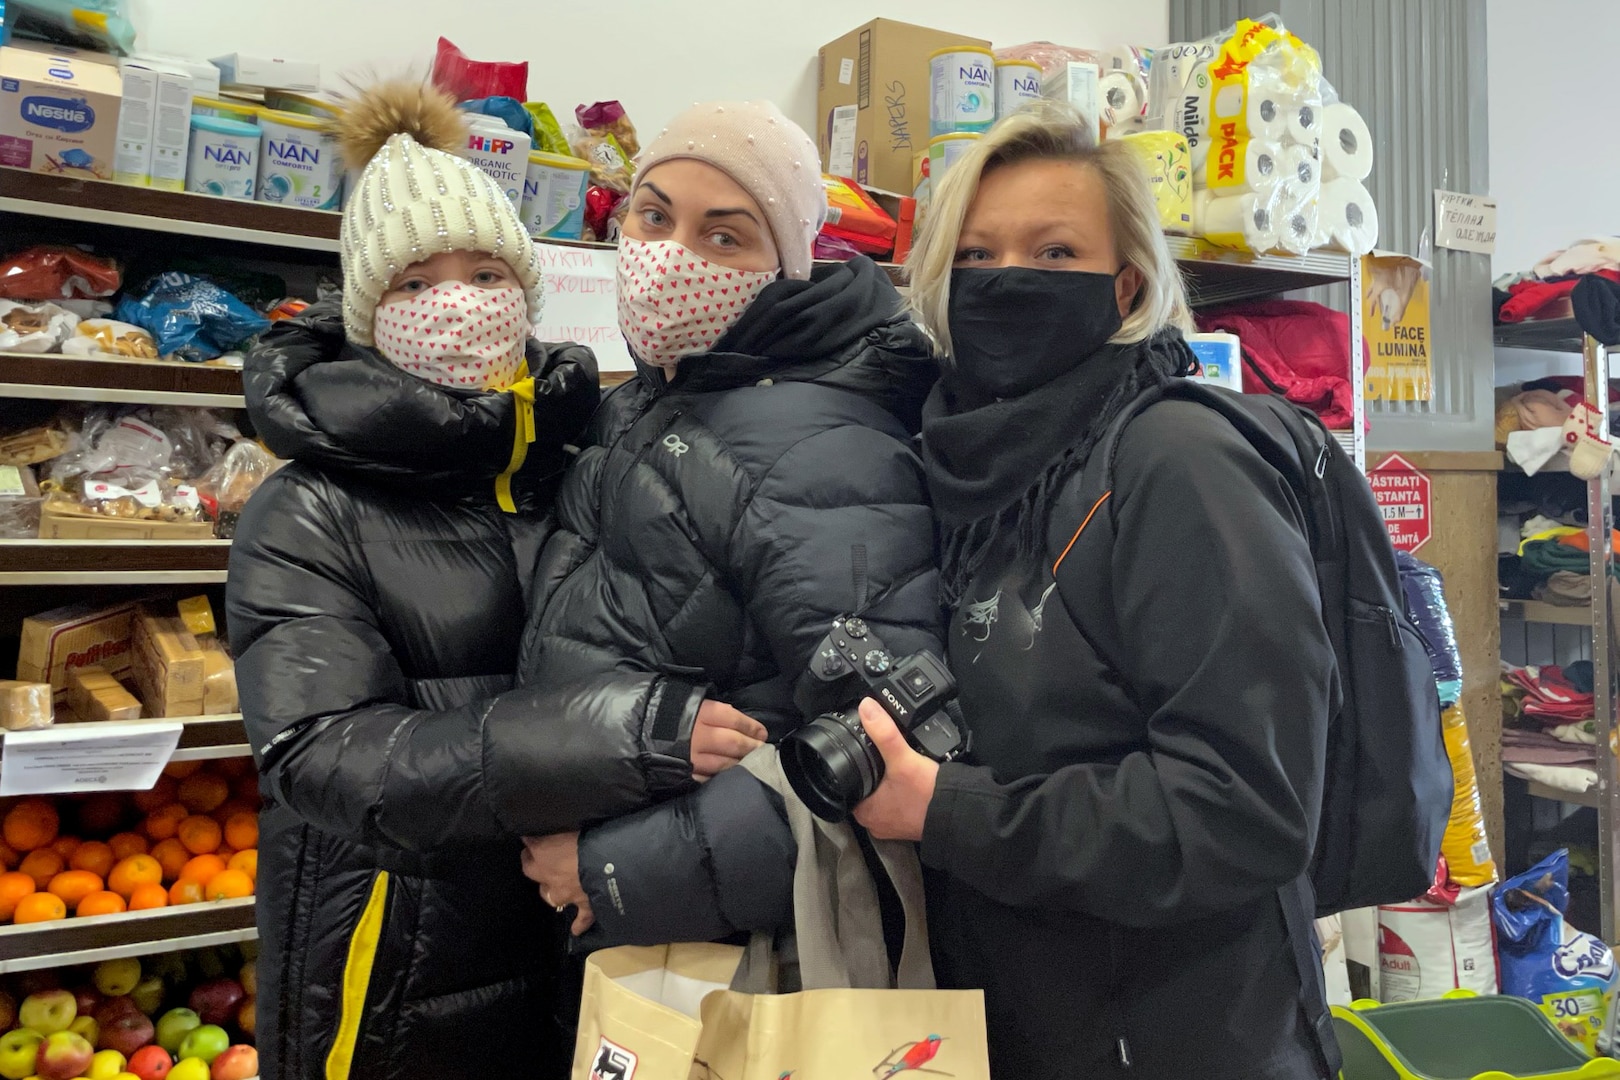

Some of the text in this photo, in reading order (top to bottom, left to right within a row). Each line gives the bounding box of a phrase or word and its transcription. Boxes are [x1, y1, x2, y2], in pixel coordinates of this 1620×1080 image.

[959, 66, 992, 84] NAN
[1184, 95, 1199, 147] Milde
[268, 140, 319, 165] NAN
[468, 135, 515, 155] HiPP
[1216, 121, 1237, 180] PACK
[204, 145, 251, 166] NAN
[272, 159, 313, 172] COMFORTIS
[244, 179, 253, 196] 2
[312, 185, 322, 198] 2
[534, 214, 542, 226] 3
[1393, 326, 1425, 341] FACE
[1377, 340, 1427, 357] LUMINĂ
[1384, 507, 1396, 518] 1.5
[1388, 524, 1400, 534] DE
[1391, 533, 1419, 546] RANȚĂ
[881, 688, 908, 715] SONY
[1381, 959, 1411, 971] Adult
[1551, 997, 1580, 1018] 30
